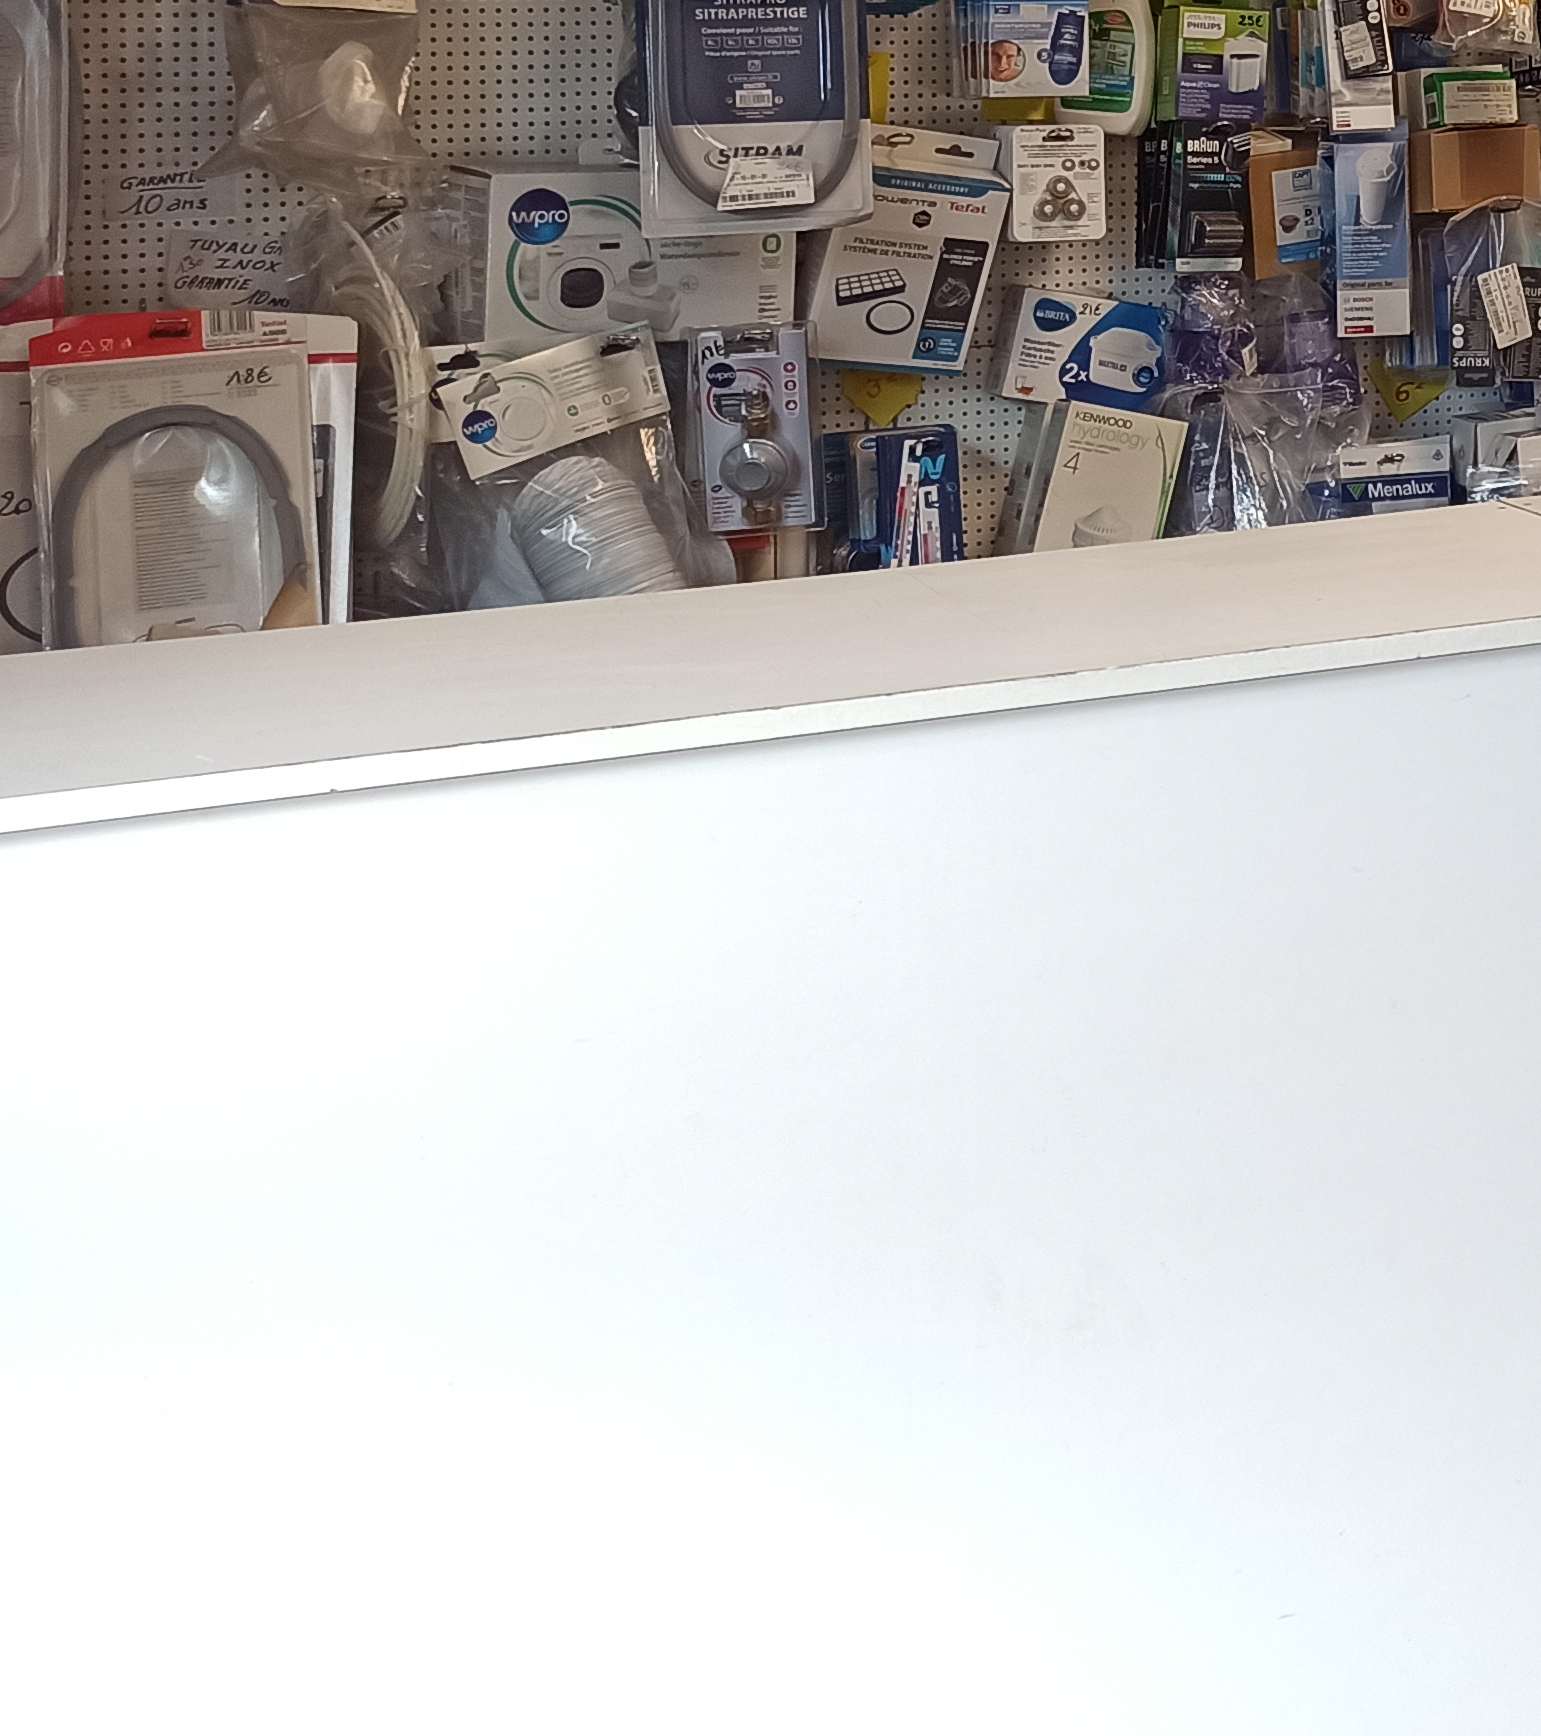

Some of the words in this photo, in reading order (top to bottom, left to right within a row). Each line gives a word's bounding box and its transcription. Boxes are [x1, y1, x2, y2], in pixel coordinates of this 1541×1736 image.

[695, 8, 808, 20] SITRAPRESTIGE
[214, 259, 281, 273] INOX
[1044, 310, 1070, 322] BRITA
[1075, 411, 1132, 429] KENWOOD
[1368, 480, 1436, 498] Menalux
